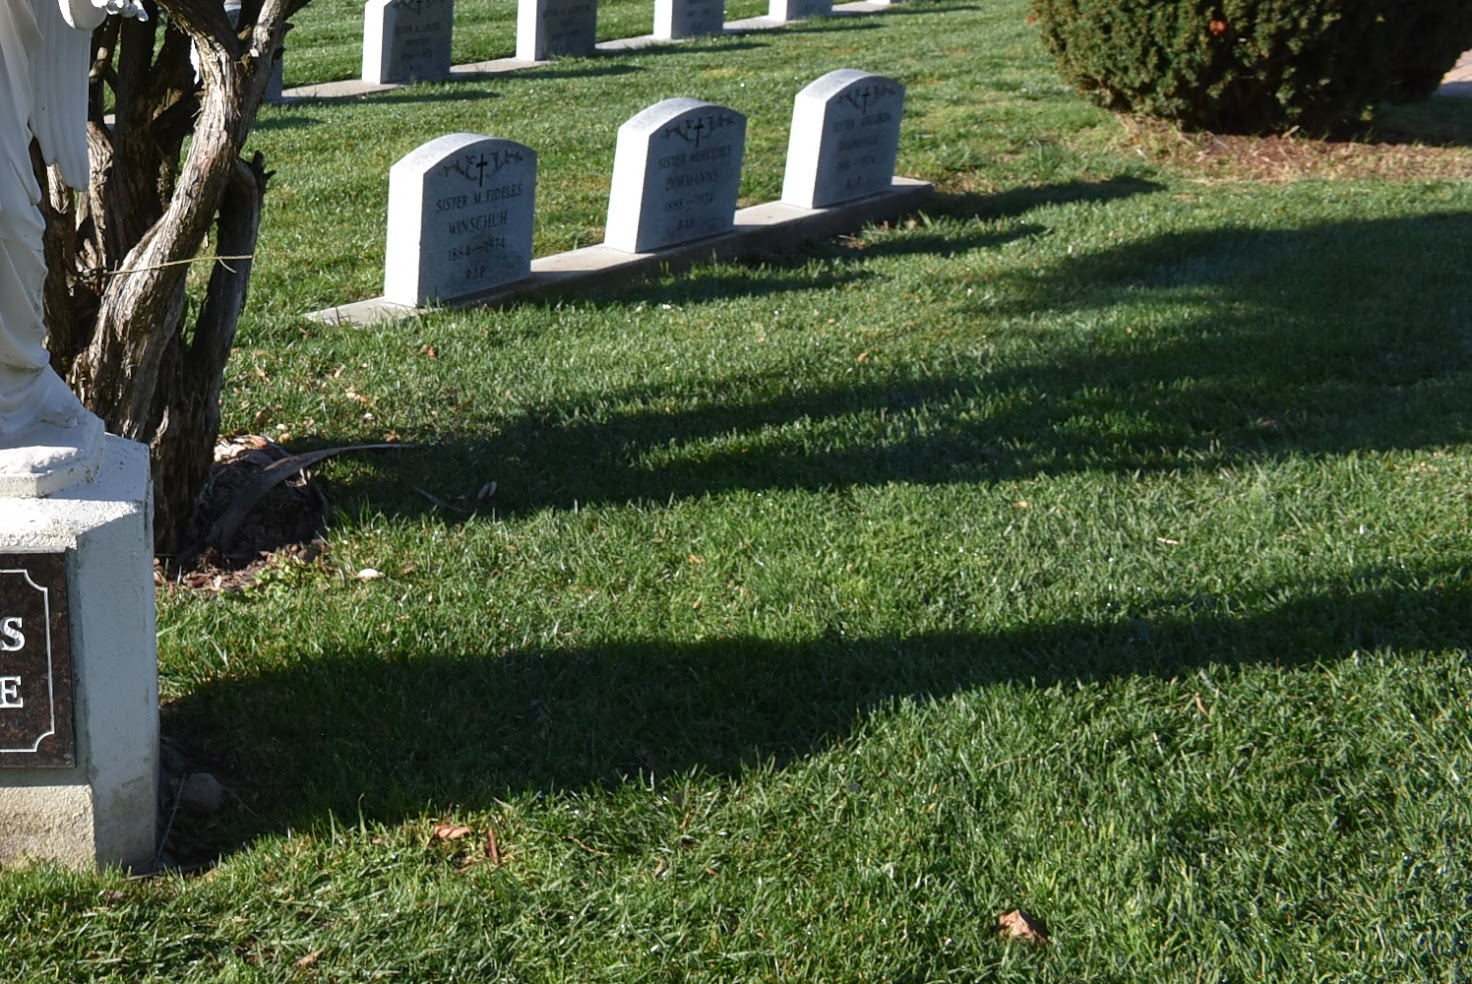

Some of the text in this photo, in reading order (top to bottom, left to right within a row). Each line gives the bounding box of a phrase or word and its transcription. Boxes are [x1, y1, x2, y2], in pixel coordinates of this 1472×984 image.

[435, 194, 468, 214] SISTER
[486, 183, 523, 204] FIDELES
[448, 210, 509, 235] WINSCHUH
